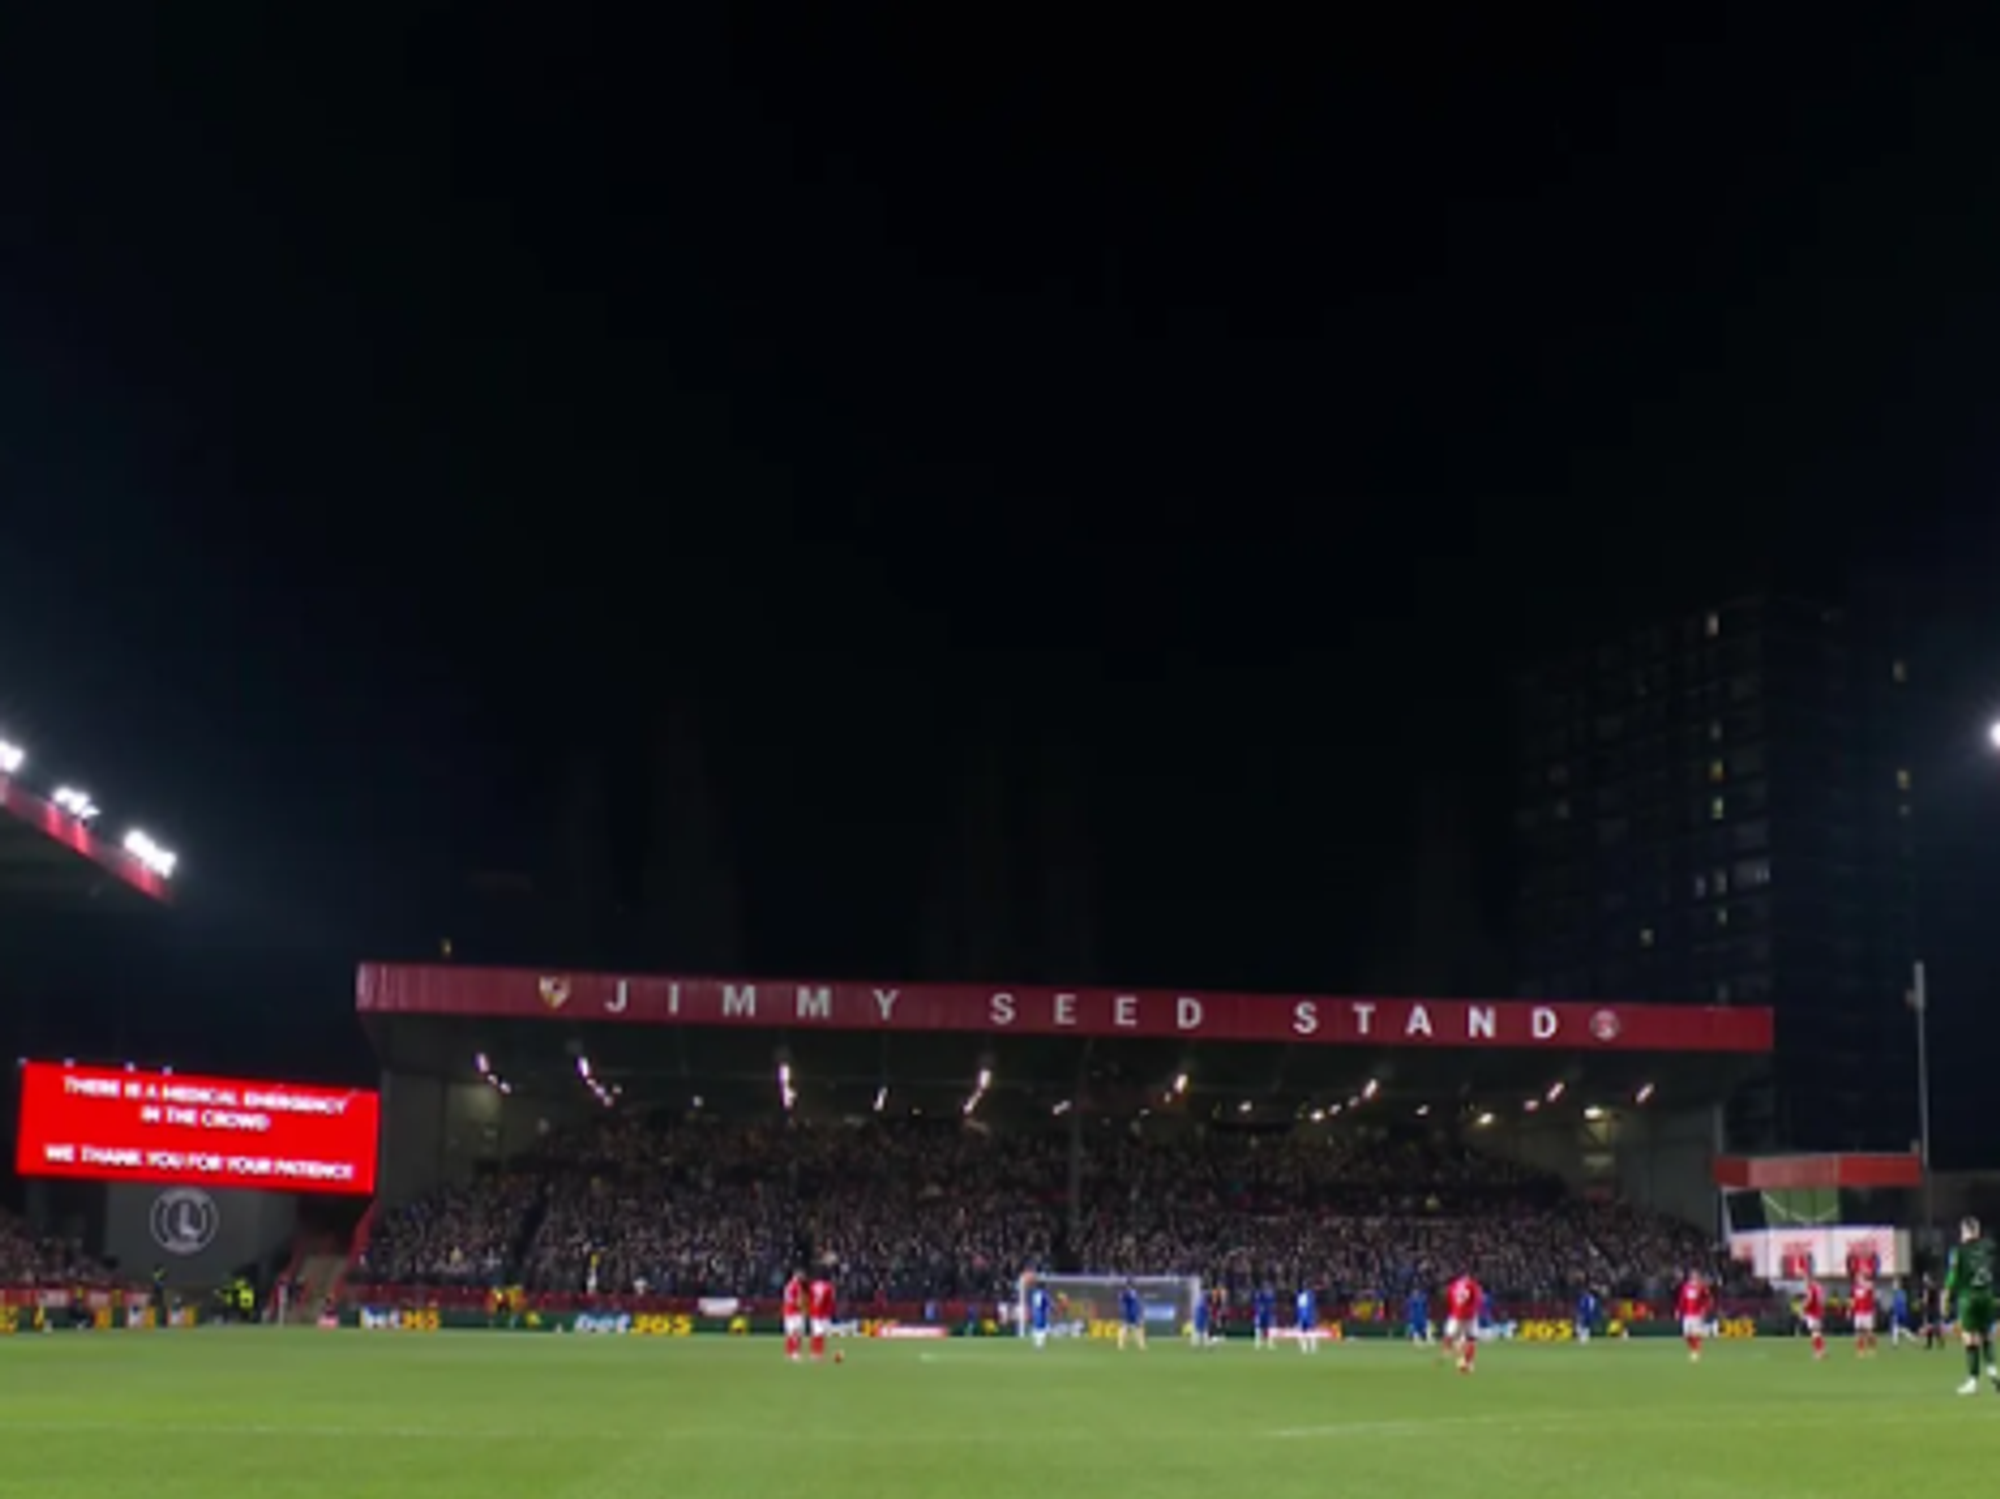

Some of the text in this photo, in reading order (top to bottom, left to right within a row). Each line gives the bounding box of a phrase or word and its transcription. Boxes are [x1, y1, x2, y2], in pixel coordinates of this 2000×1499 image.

[604, 979, 1557, 1038] JIMMY SEED STAND
[64, 1075, 348, 1115] THERE IS A MEDICAL EMERGENCY
[141, 1105, 270, 1131] IN THE CROWD
[45, 1144, 354, 1180] WE THANK YOU FOR YOUR PATIENCE
